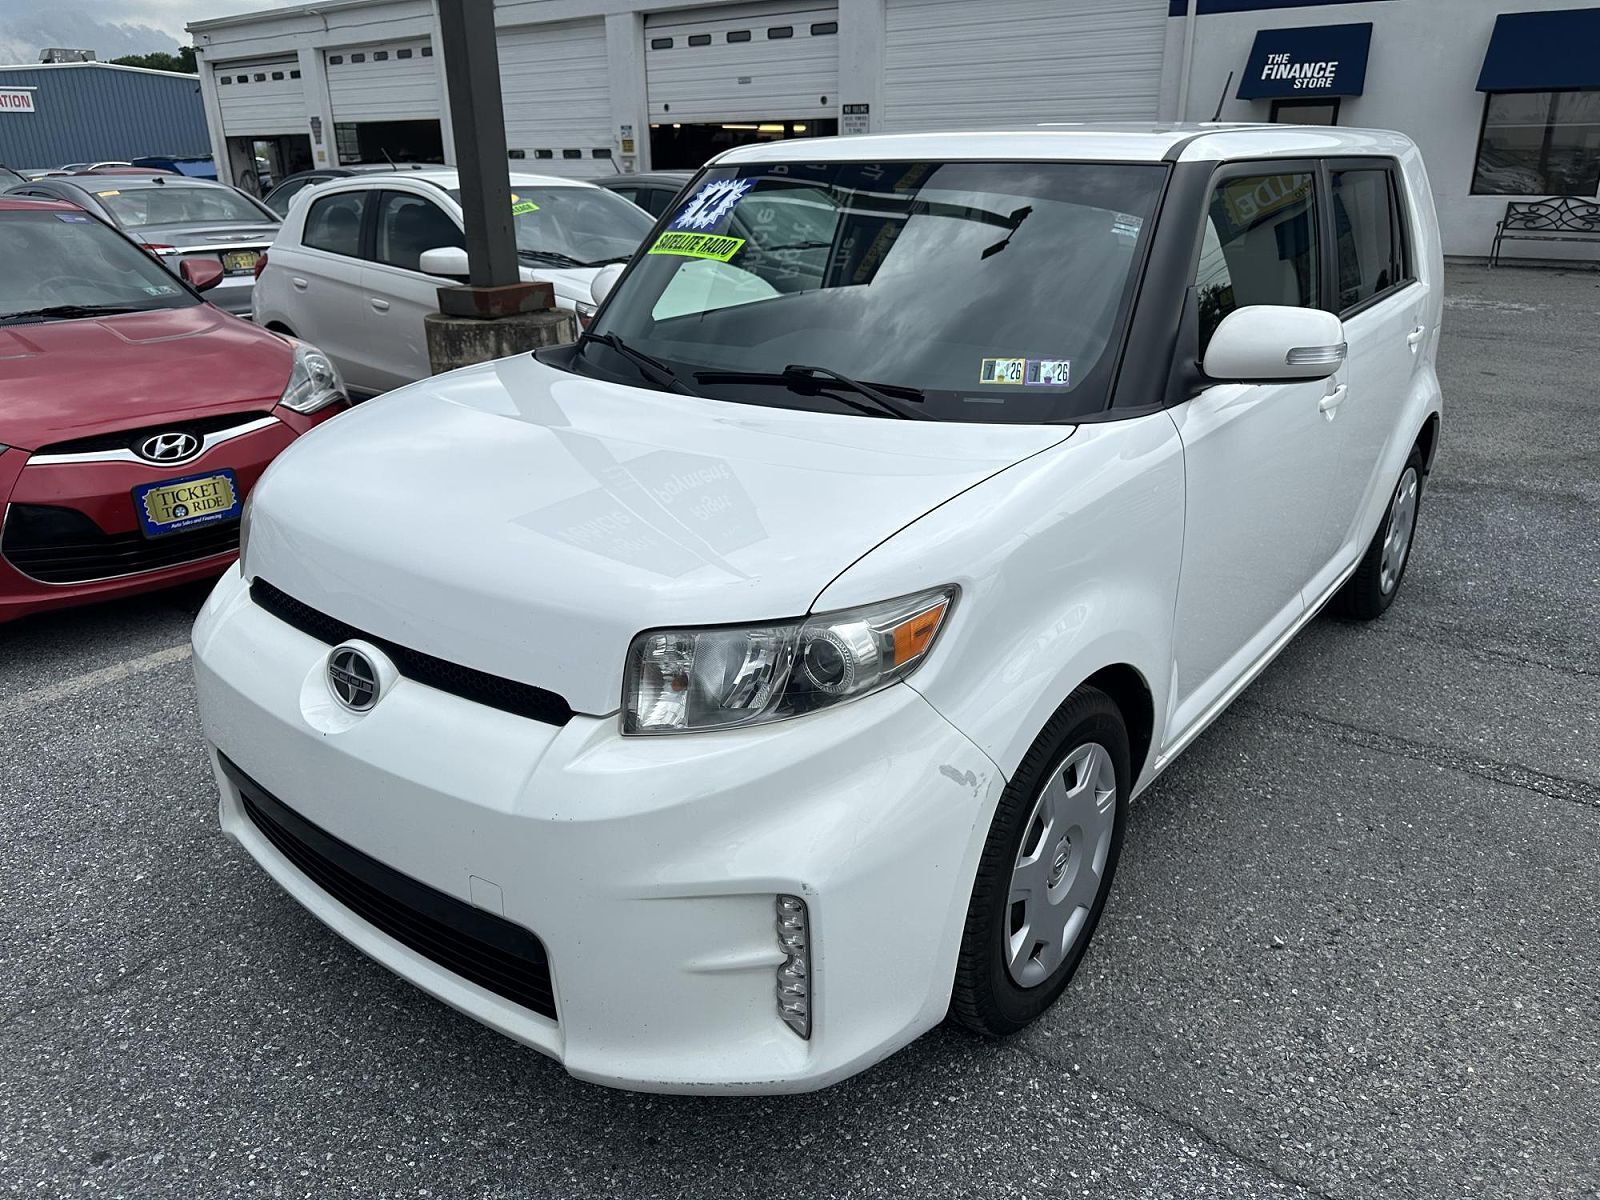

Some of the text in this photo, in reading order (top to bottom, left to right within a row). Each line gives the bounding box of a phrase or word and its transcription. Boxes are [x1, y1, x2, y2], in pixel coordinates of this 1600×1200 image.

[1267, 53, 1290, 64] THE
[1260, 61, 1339, 80] FINANCE
[1293, 77, 1334, 89] STORE
[655, 233, 738, 257] SATELLITE RADIO
[1010, 362, 1022, 380] 26
[1057, 364, 1068, 382] 26
[157, 481, 220, 507] TICKET
[192, 495, 224, 512] RIDE
